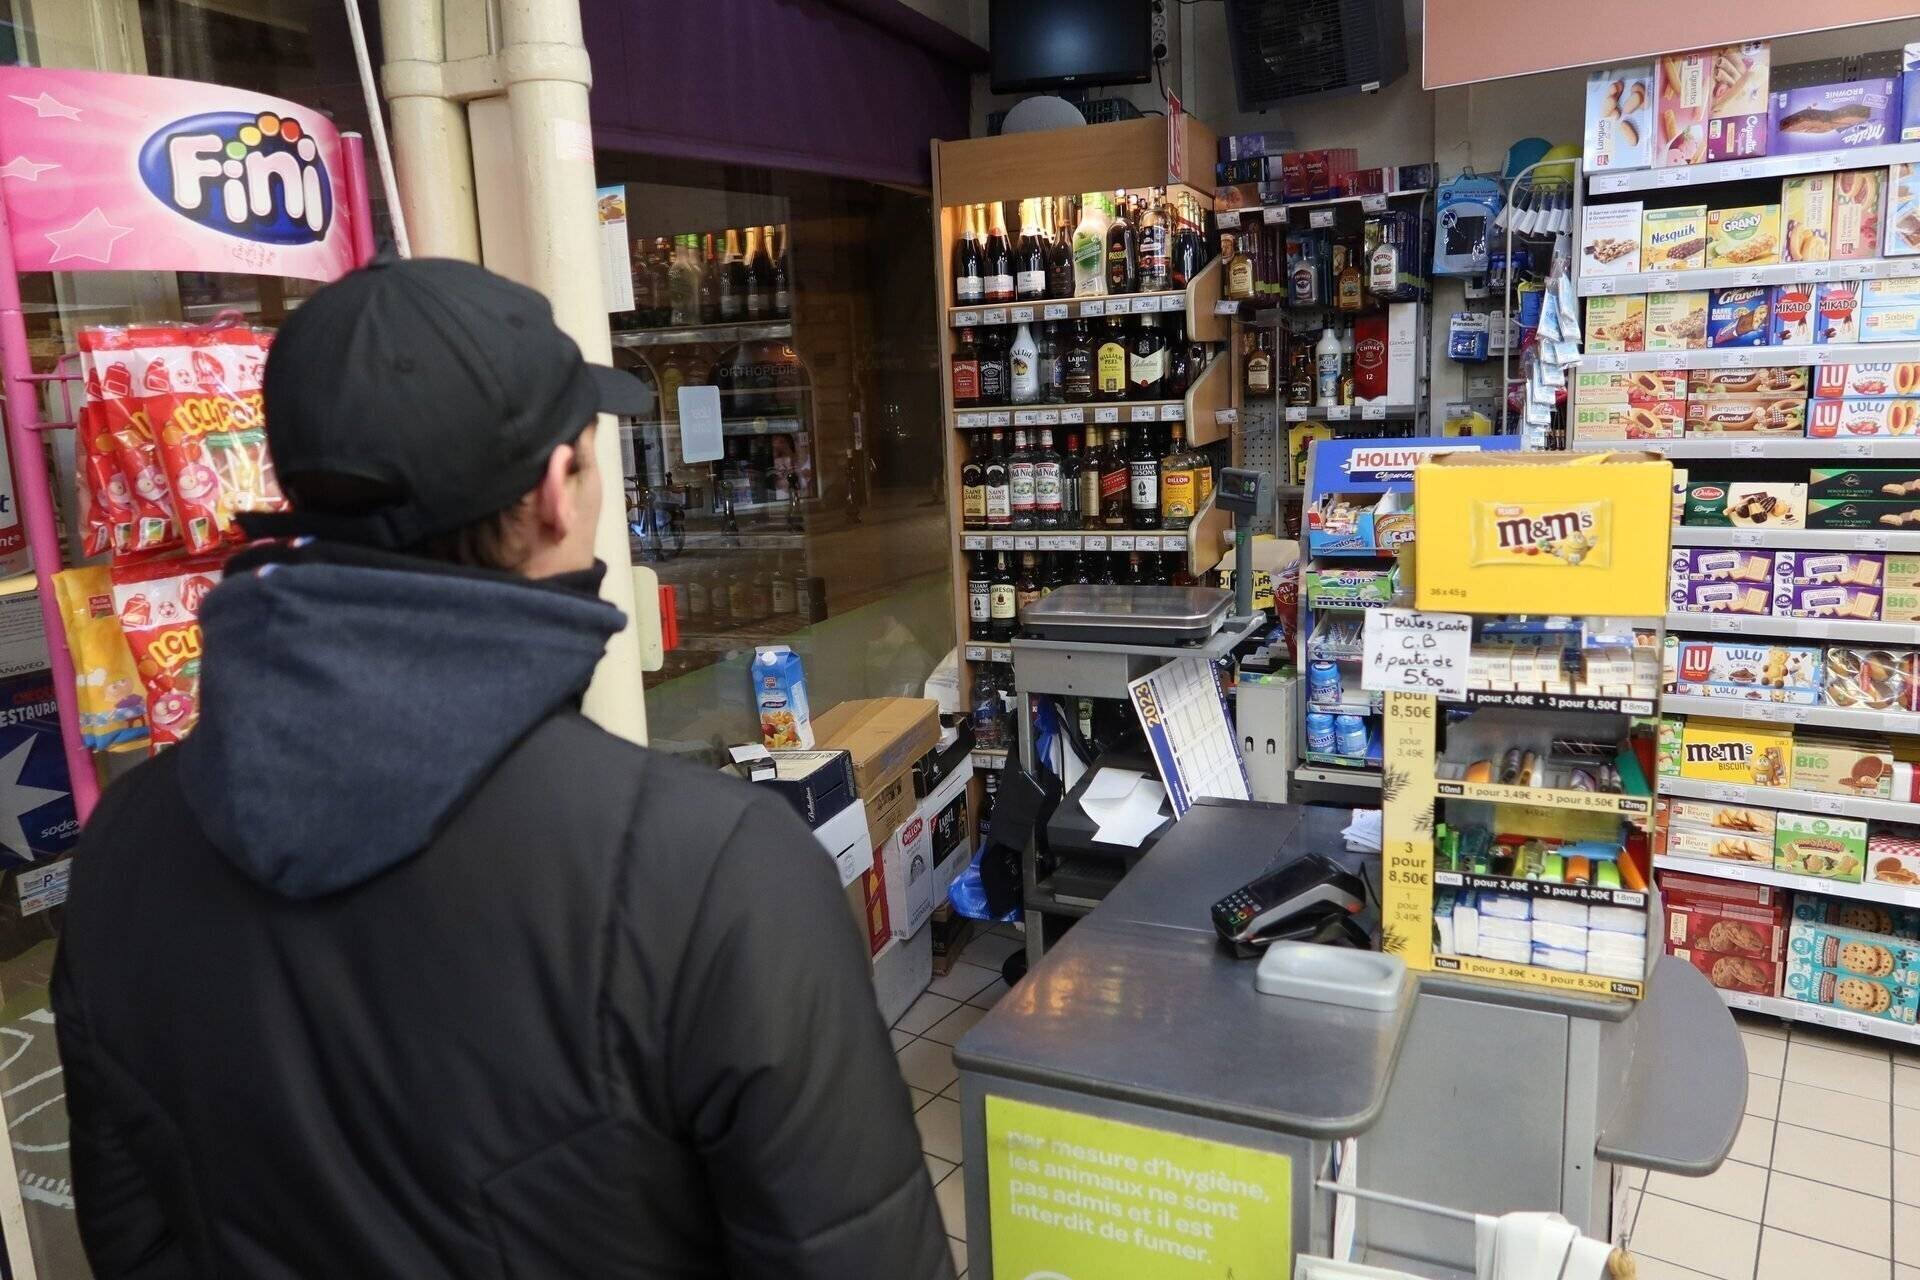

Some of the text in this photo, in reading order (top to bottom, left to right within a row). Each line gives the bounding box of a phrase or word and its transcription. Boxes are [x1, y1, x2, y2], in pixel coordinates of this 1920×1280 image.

[1825, 87, 1864, 99] BROWNIE
[1841, 123, 1885, 145] Milka
[169, 120, 322, 234] Fini
[1710, 211, 1719, 223] LU
[1721, 214, 1762, 232] GRANY
[1651, 224, 1696, 245] Nesquik
[1718, 286, 1764, 305] Granola
[1774, 302, 1812, 314] MIKADO
[1818, 299, 1858, 311] MIKADO
[1359, 344, 1380, 352] CHIVAS
[1822, 365, 1841, 387] LU
[1711, 404, 1751, 414] Barquettes
[1849, 401, 1885, 414] LULU
[1578, 411, 1607, 423] BIO
[1717, 413, 1745, 422] Chocolat
[1815, 405, 1835, 426] LU
[1497, 511, 1593, 548] m&m's
[1391, 531, 1416, 543] CRA
[1315, 596, 1384, 609] mentos
[1379, 612, 1434, 629] Toutes
[1432, 654, 1453, 667] de
[1685, 649, 1707, 671] LU
[1726, 649, 1763, 662] LULU
[1714, 686, 1738, 695] LULU
[1135, 684, 1162, 728] 2023
[1477, 694, 1503, 704] pour
[1504, 694, 1534, 705] 3,49€
[1548, 697, 1556, 706] 3
[1558, 699, 1585, 709] pour
[1586, 699, 1618, 711] 8,50€
[1391, 705, 1432, 719] 8,50€
[1399, 738, 1422, 747] pour
[1396, 748, 1425, 758] 3,49€
[1686, 742, 1753, 762] m&m's
[1718, 762, 1746, 771] BISCUIT
[1795, 756, 1829, 769] BIO
[1439, 785, 1462, 793] 10ml
[1476, 788, 1501, 797] pour
[1503, 789, 1531, 799] 3,49€
[1546, 793, 1553, 801] 3
[1556, 795, 1582, 804] pour
[1584, 797, 1614, 807] 8,50€
[1620, 800, 1647, 810] 12mg
[1687, 807, 1710, 818] Beurre
[938, 807, 954, 833] LABEL
[903, 820, 922, 844] DILLON
[1404, 842, 1413, 854] 3
[1686, 838, 1708, 848] Beurre
[1391, 856, 1427, 868] pour
[1388, 871, 1429, 886] 8,50€
[1473, 879, 1496, 890] pour
[1499, 880, 1529, 892] 3,49€
[1543, 884, 1550, 893] 3
[1554, 886, 1578, 897] pour
[1580, 887, 1610, 900] 8,50€
[1396, 901, 1419, 912] pour
[1393, 912, 1422, 923] 3,49€
[1814, 935, 1824, 964] COOKIES
[1436, 959, 1458, 969] 10ml
[1472, 964, 1496, 975] pour
[1499, 966, 1526, 978] 3,49€
[1541, 972, 1548, 981] 3
[1551, 974, 1575, 986] pour
[1577, 976, 1607, 989] 8,50€
[1612, 983, 1638, 994] 12mg
[1811, 971, 1822, 999] COOKIES
[1051, 1140, 1137, 1173] mesure
[1143, 1158, 1270, 1204] d'hygiène,
[1007, 1152, 1239, 1221] les animaux ne sont
[1008, 1179, 1214, 1240] pas admis et il est
[1010, 1201, 1212, 1264] interdit de fumer.
